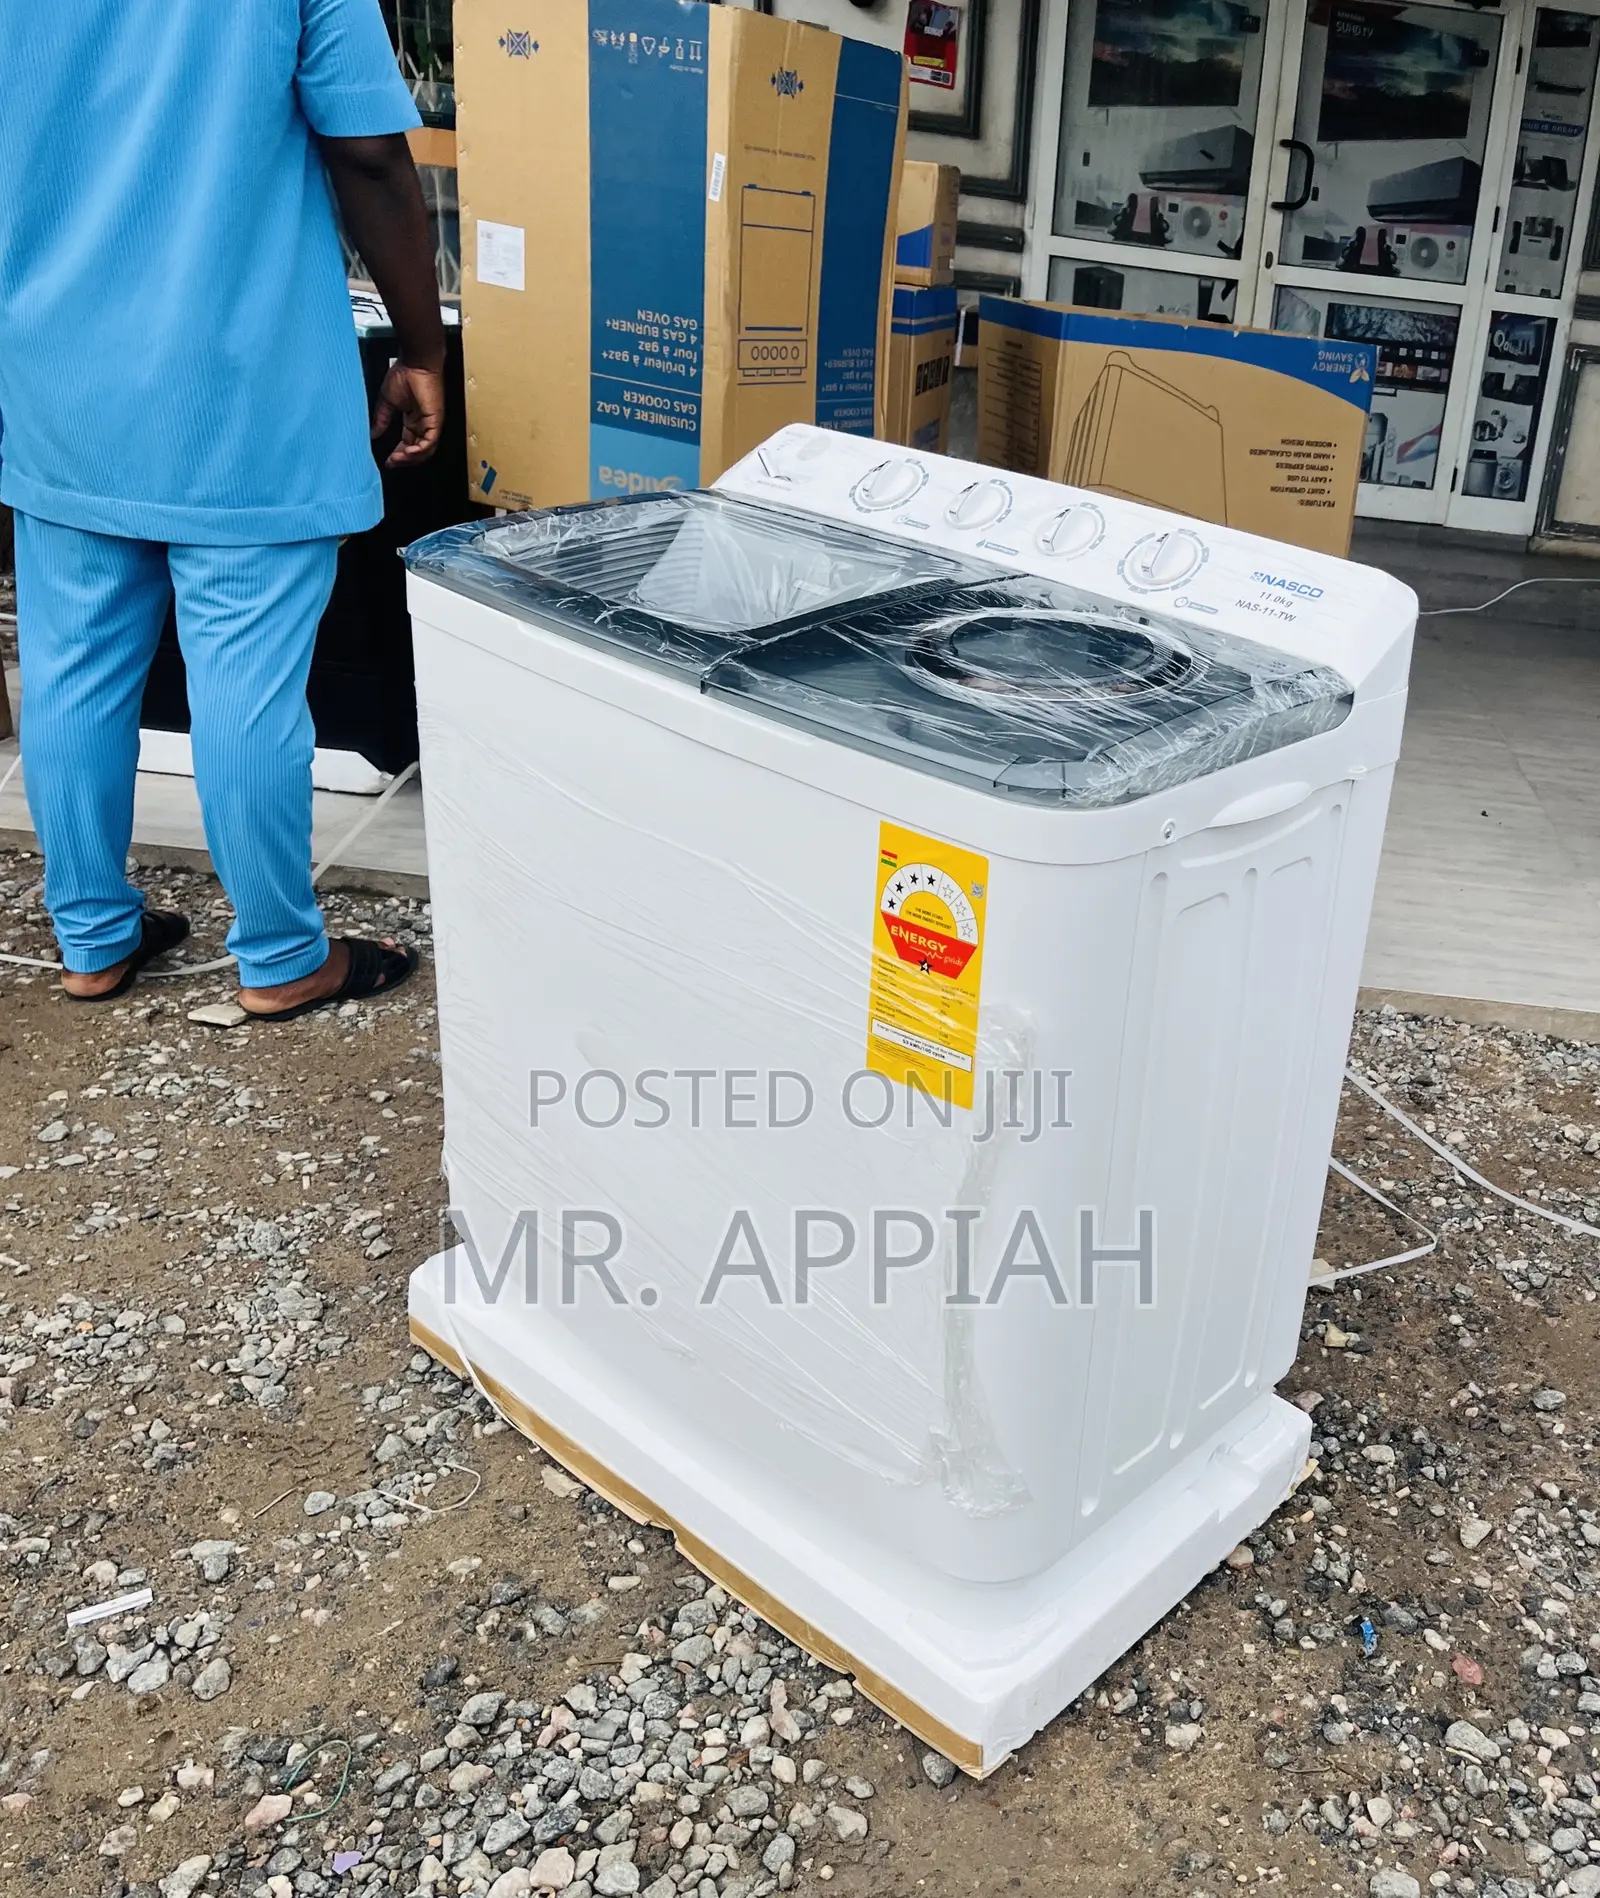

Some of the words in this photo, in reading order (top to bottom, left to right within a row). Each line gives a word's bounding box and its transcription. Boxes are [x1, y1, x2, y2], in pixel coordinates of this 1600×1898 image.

[637, 309, 670, 325] OVEN
[673, 316, 698, 330] GAS
[605, 318, 659, 337] BURNER+
[662, 328, 686, 342] GAS
[638, 341, 660, 353] gaz
[690, 334, 697, 345] 4
[601, 350, 629, 362] gaz+
[663, 345, 670, 358] à
[673, 348, 697, 363] four
[1318, 350, 1353, 361] SAVING
[633, 354, 640, 367] à
[643, 356, 686, 376] brûleur
[1312, 362, 1352, 373] ENERGY
[689, 366, 697, 377] 4
[623, 390, 671, 410] COOKER
[673, 400, 697, 415] GAS
[596, 401, 620, 416] GAZ
[634, 408, 697, 431] CUISINIÈRE
[1276, 462, 1304, 470] EXPRESS
[1261, 574, 1324, 598] NASCO
[1259, 591, 1293, 608] 11.0kg
[1234, 599, 1297, 622] NAS-11-TW
[890, 924, 948, 953] ENERGY
